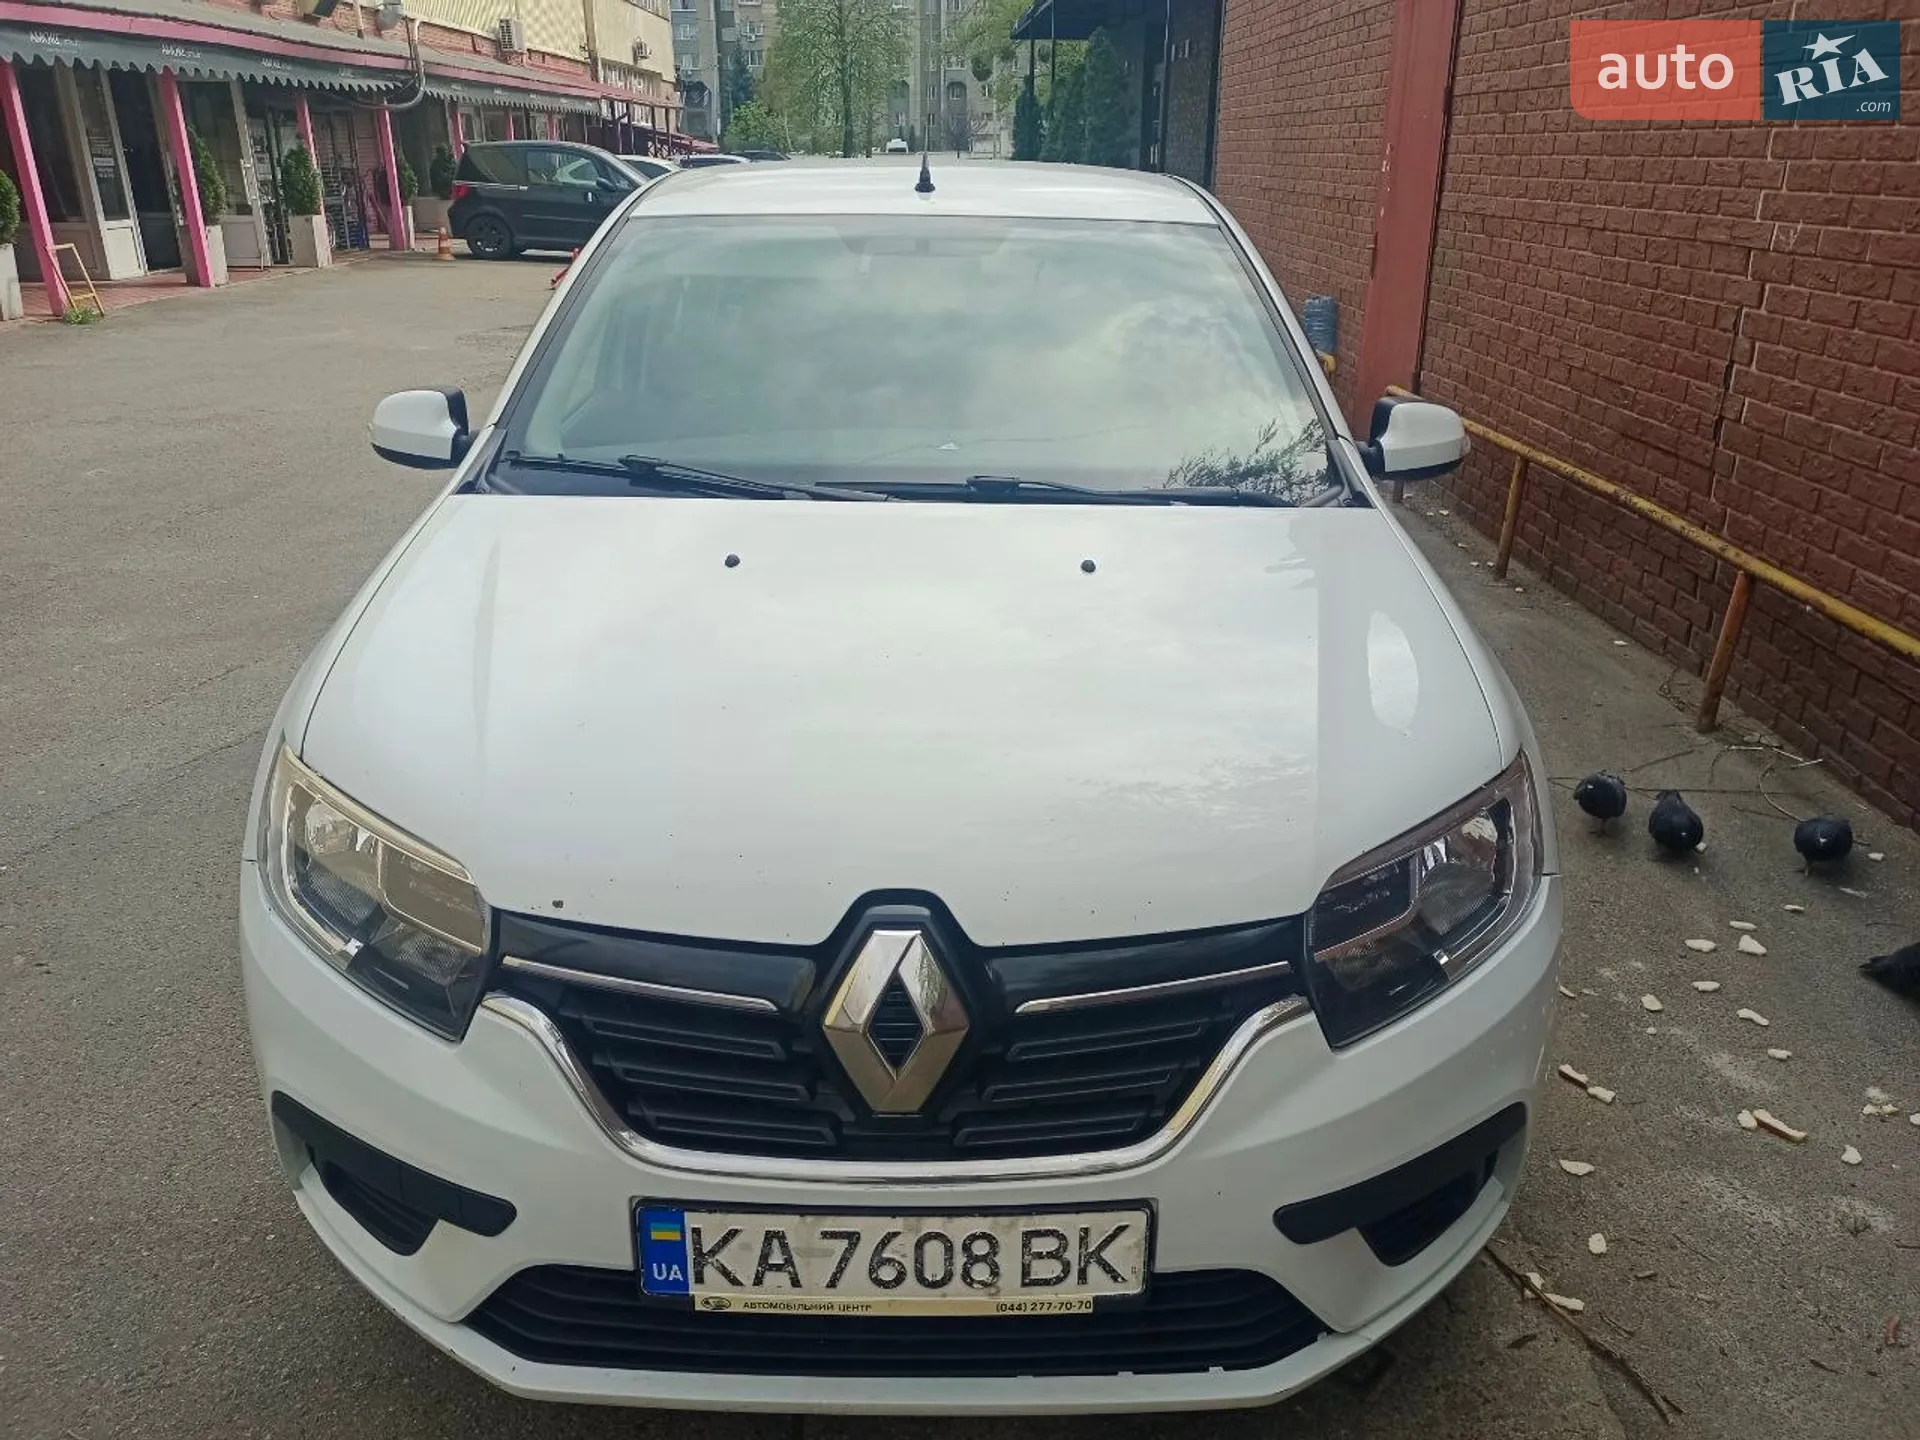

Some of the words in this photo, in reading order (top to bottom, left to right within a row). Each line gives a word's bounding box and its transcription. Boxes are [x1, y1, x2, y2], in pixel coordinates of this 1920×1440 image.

[690, 1226, 804, 1288] KA
[820, 1230, 1001, 1290] 7608
[1020, 1224, 1131, 1288] BK
[652, 1263, 684, 1281] UA
[996, 1302, 1027, 1312] (044)
[1030, 1300, 1092, 1311] 277-70-70
